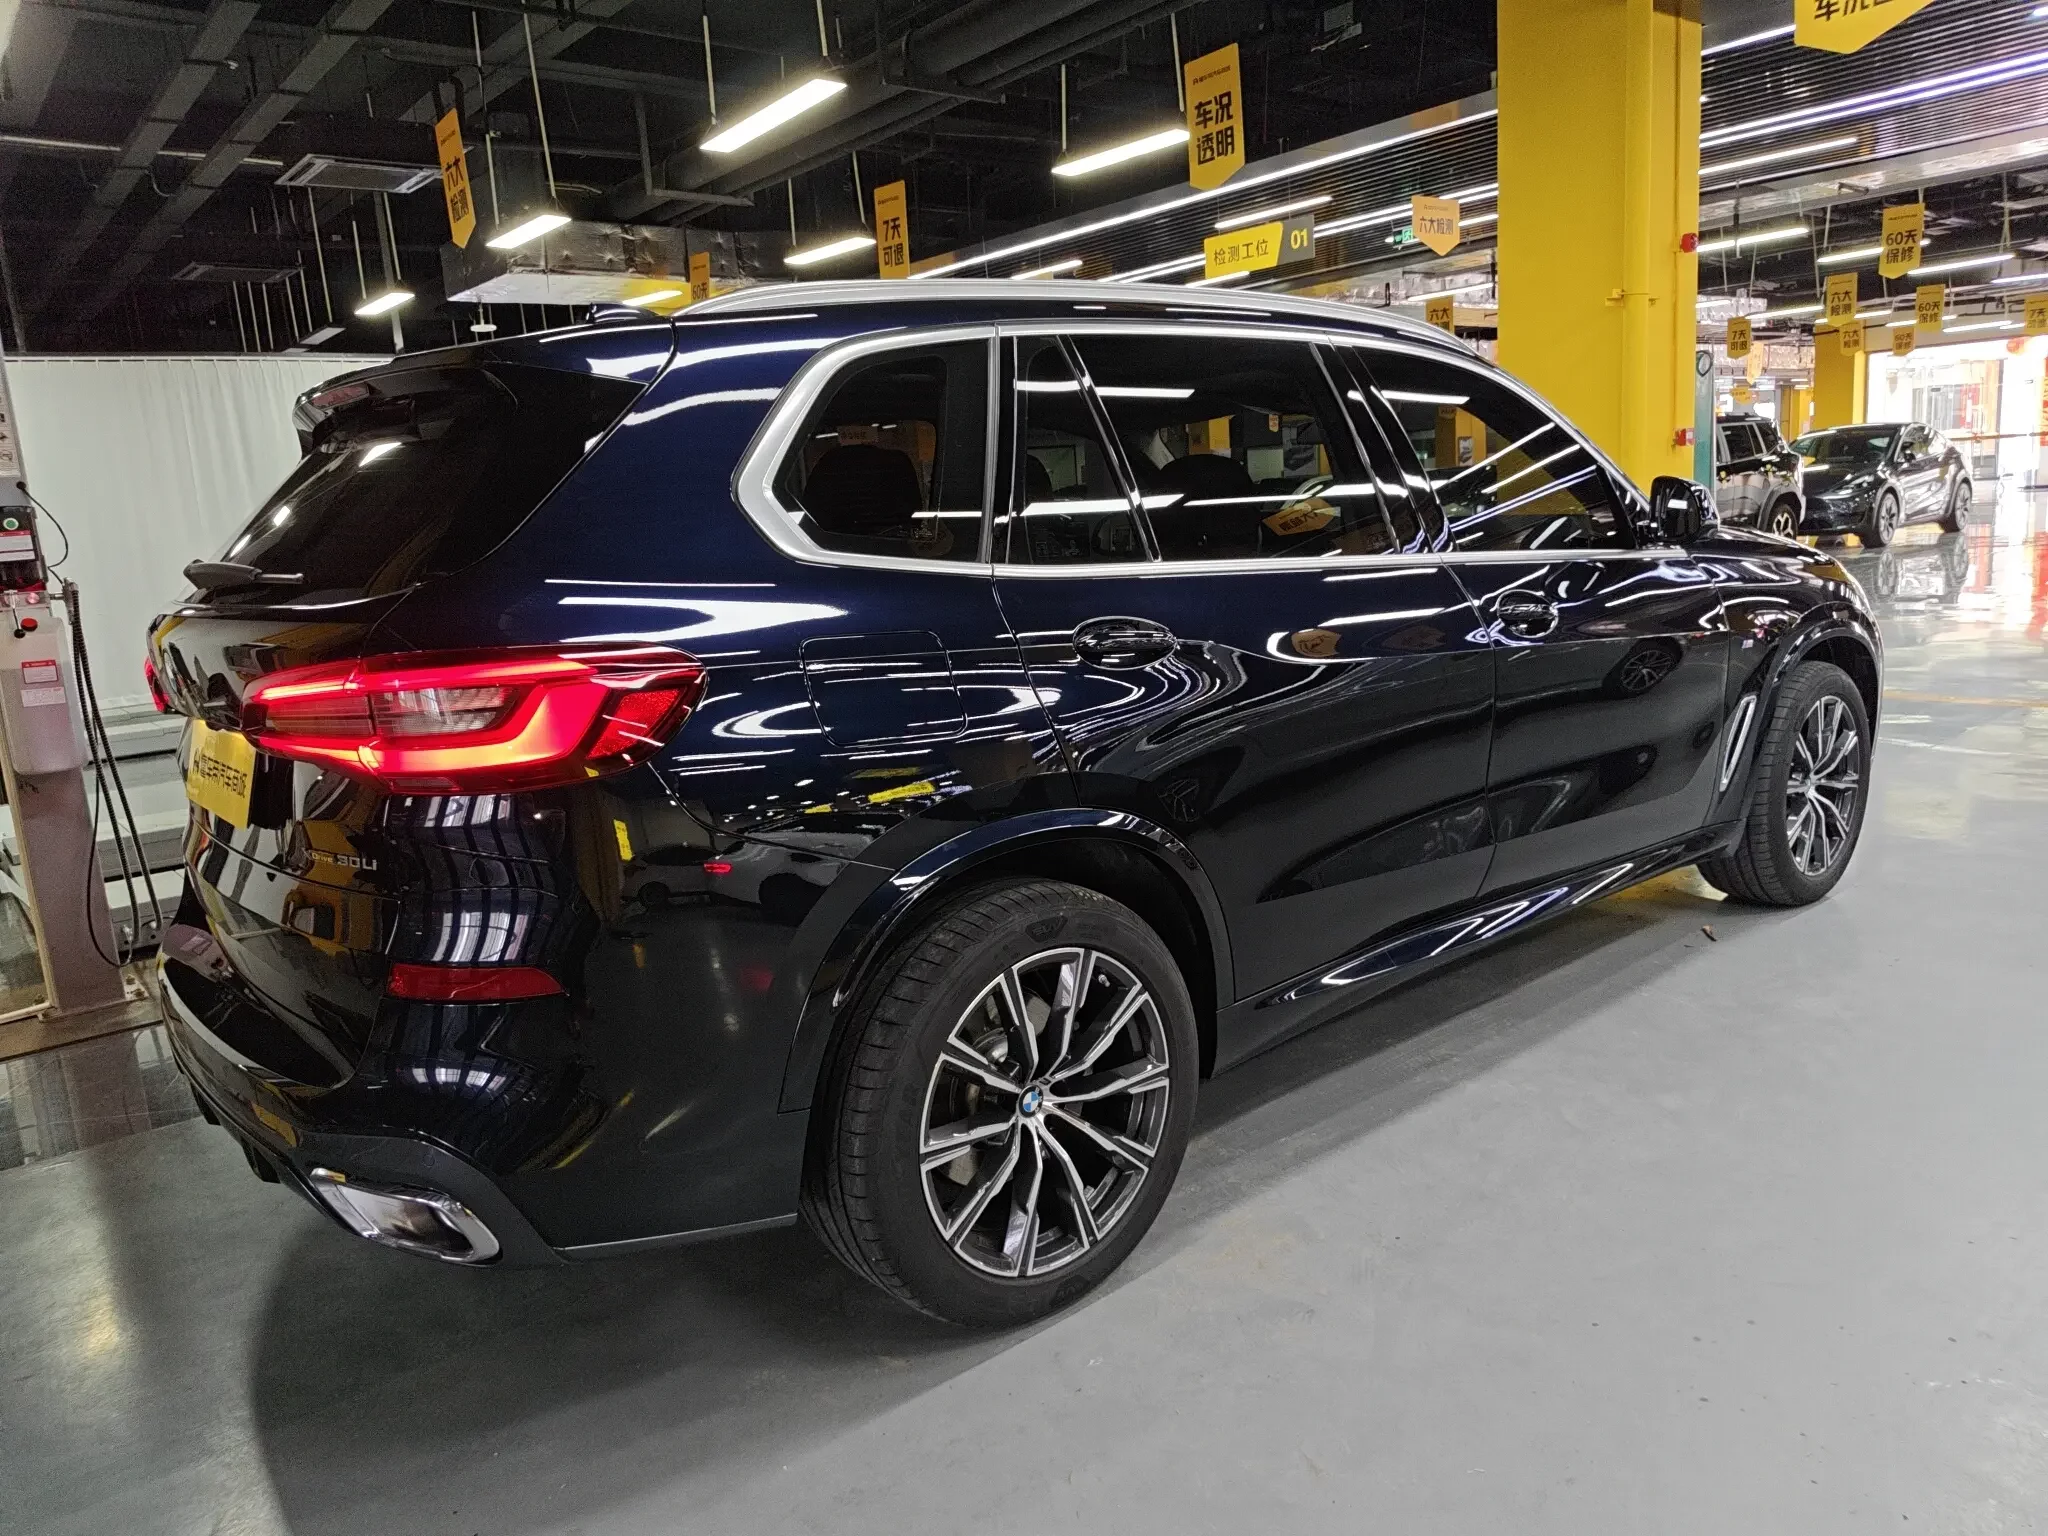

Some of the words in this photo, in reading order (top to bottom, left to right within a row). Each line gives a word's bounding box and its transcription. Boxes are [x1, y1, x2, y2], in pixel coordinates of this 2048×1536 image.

[1194, 91, 1233, 129] 车况
[1197, 125, 1235, 165] 透明
[445, 156, 463, 192] 六大
[883, 217, 901, 242] 7天
[1419, 216, 1454, 235] 六大检测
[1886, 229, 1917, 246] 60天
[883, 243, 904, 267] 可退
[1214, 238, 1269, 266] 检测工位
[1291, 228, 1308, 249] 01
[1886, 246, 1914, 264] 保修
[693, 282, 707, 300] 60天
[1831, 290, 1852, 304] 六大
[1429, 307, 1450, 321] 六大
[1918, 301, 1940, 312] 60天
[1732, 330, 1747, 340] 7天
